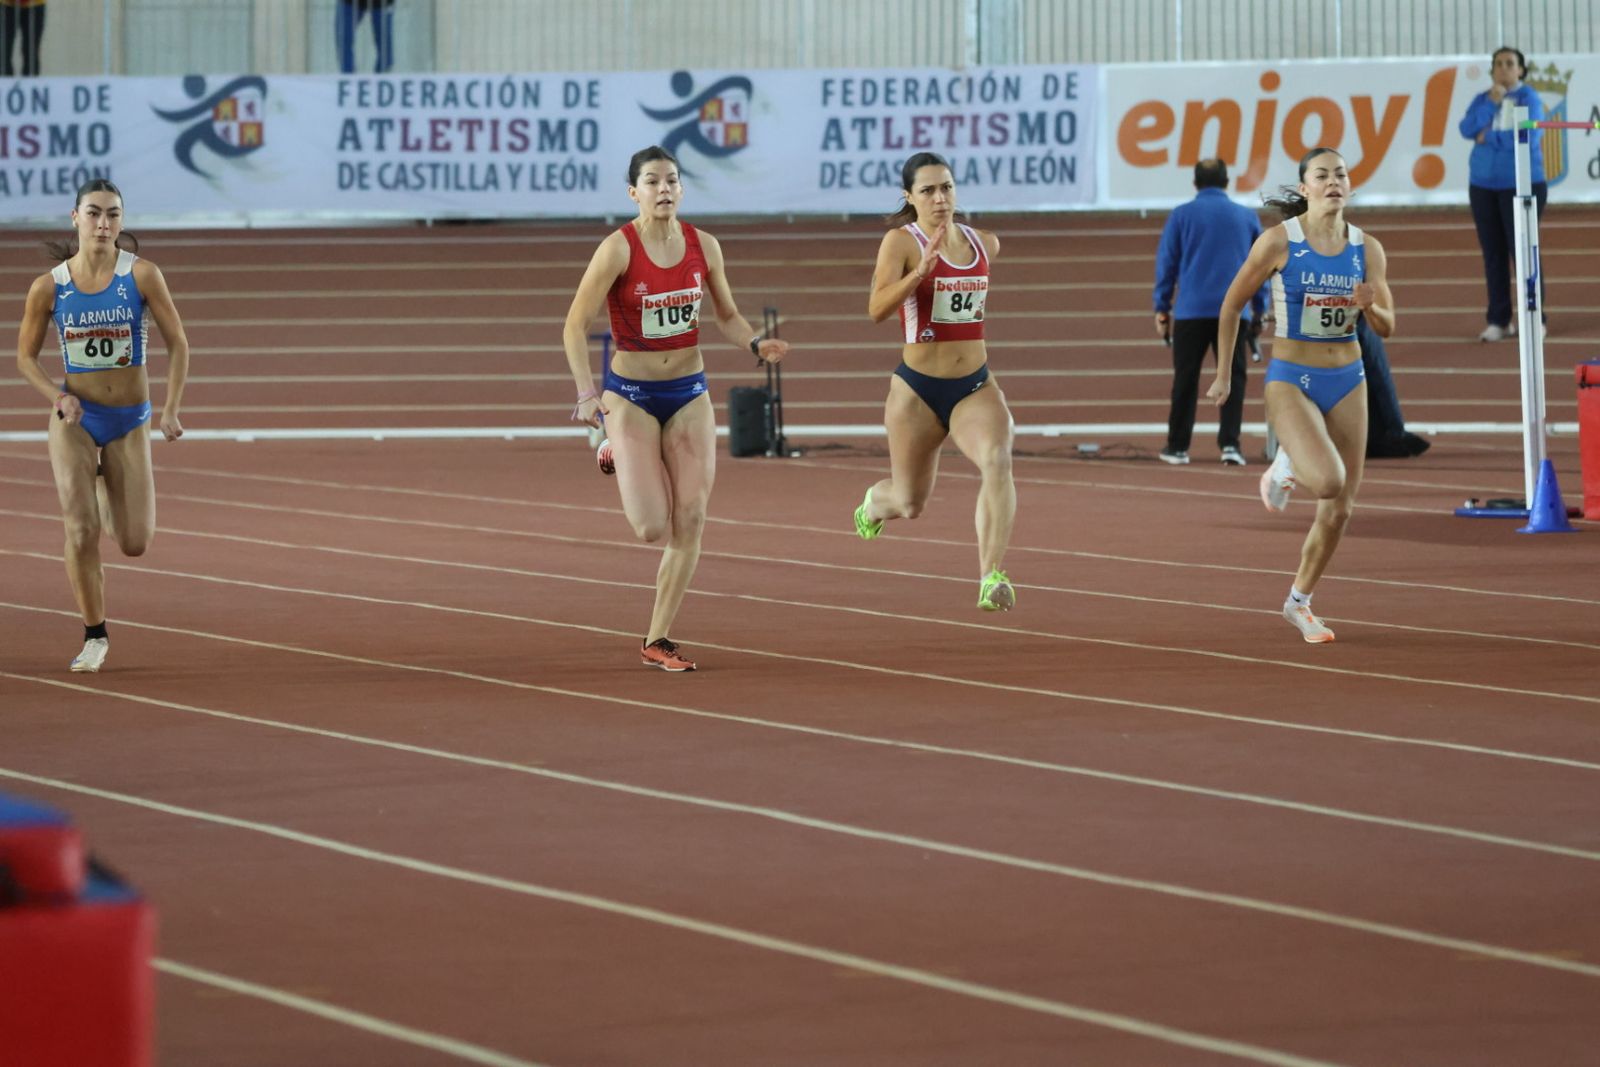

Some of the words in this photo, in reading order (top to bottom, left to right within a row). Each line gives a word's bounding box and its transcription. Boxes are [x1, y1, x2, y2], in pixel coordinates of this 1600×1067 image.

[73, 84, 111, 114] DE
[337, 76, 541, 108] FEDERACIÓN
[563, 80, 600, 108] DE
[821, 70, 1021, 107] FEDERACIÓN
[1041, 71, 1078, 101] DE
[336, 118, 599, 152] ATLETISMO
[820, 110, 1077, 151] ATLETISMO
[1117, 66, 1457, 192] enjoy!
[17, 167, 34, 196] Y
[338, 162, 371, 191] DE
[377, 162, 500, 191] CASTILLA
[506, 162, 523, 191] Y
[531, 157, 598, 192] LEÓN
[819, 161, 852, 189] DE
[858, 156, 980, 188] CASLA
[986, 156, 1002, 185] Y
[1009, 149, 1076, 185] LEÓN
[1301, 271, 1315, 285] LA
[645, 291, 702, 309] bedunia
[951, 292, 973, 313] 84
[62, 312, 74, 326] LA
[79, 306, 134, 324] ARMUÑA
[654, 304, 694, 327] 108
[1320, 308, 1345, 328] 50
[85, 338, 114, 358] 60
